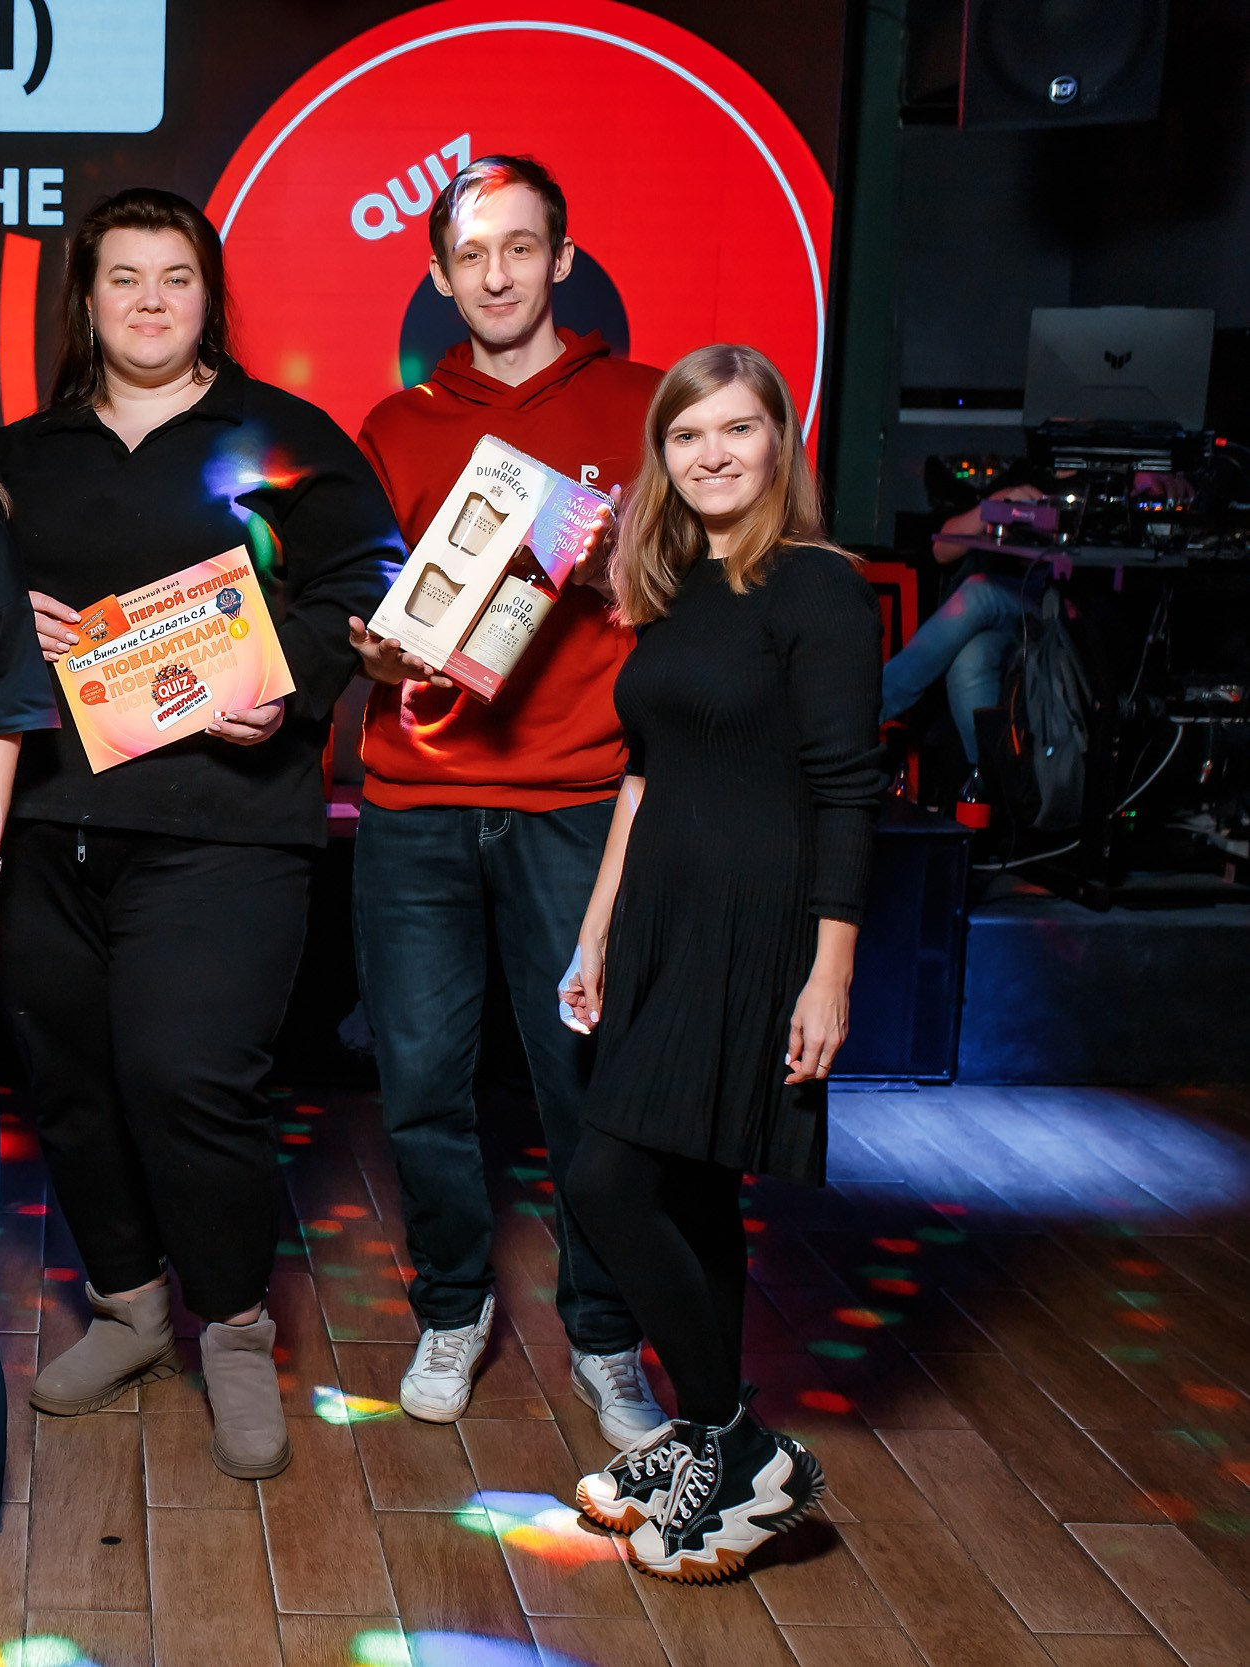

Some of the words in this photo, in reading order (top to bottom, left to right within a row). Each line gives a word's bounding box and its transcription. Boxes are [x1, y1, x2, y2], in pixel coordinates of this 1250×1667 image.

[501, 461, 521, 477] OLD
[476, 466, 529, 501] DUMBRECK
[120, 587, 161, 608] ЗЫКАЛЬНЫЙ
[129, 590, 185, 624] ПЕРВОЙ
[187, 565, 250, 599] СТЕПЕНИ
[512, 596, 533, 613] OLD
[490, 603, 536, 637] DUMBRECK
[68, 658, 92, 671] Пить
[93, 646, 119, 661] Вино
[102, 617, 226, 680] ПОБЕДИТЕЛИ!
[158, 677, 191, 699] QUIZ
[195, 693, 209, 705] GAME
